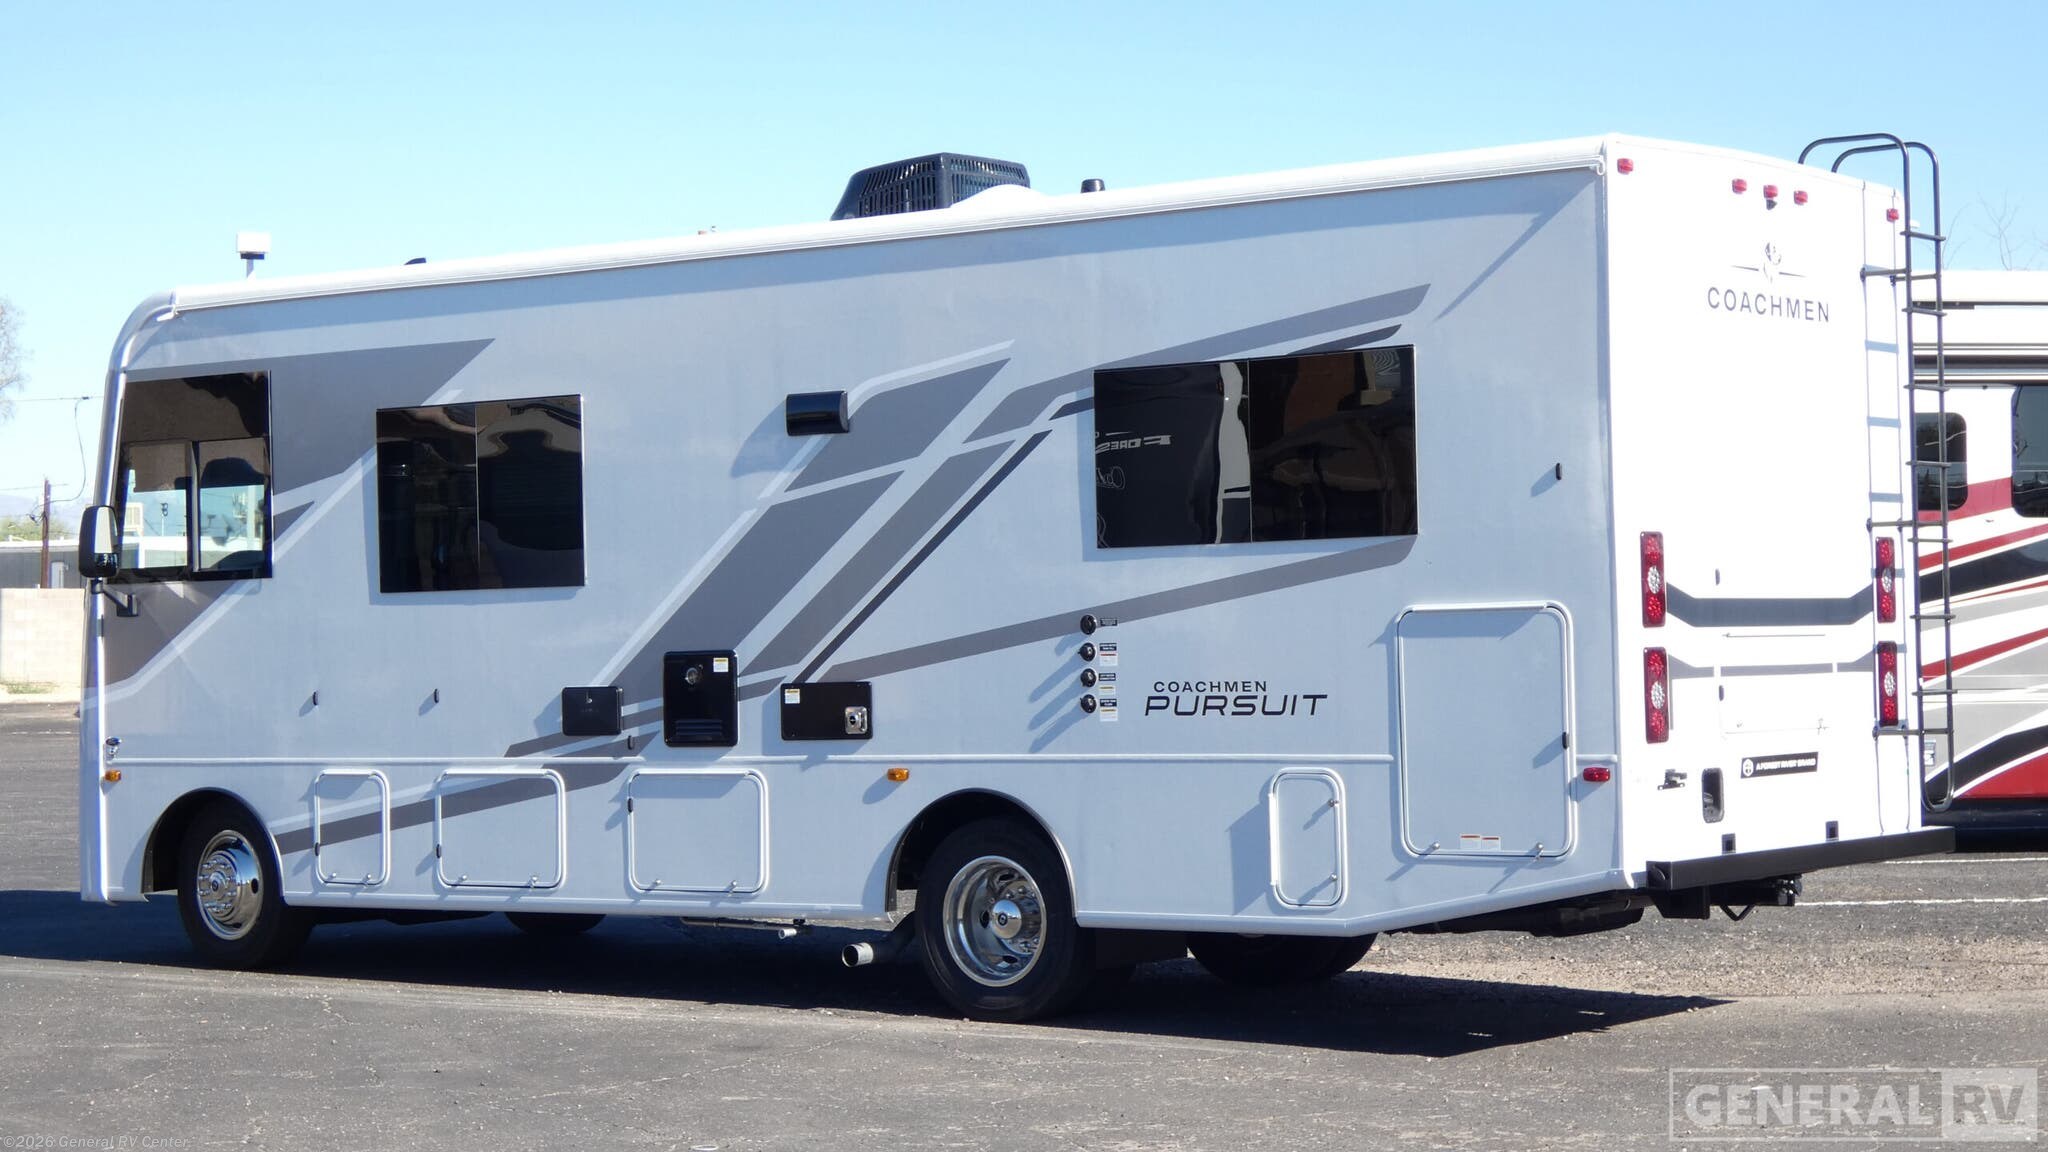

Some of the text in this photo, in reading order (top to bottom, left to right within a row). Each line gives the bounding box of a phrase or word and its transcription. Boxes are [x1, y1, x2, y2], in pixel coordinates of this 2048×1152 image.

[1707, 286, 1829, 322] COACHMEN
[1153, 681, 1267, 693] COACHMEN
[1144, 694, 1328, 717] PURSUIT
